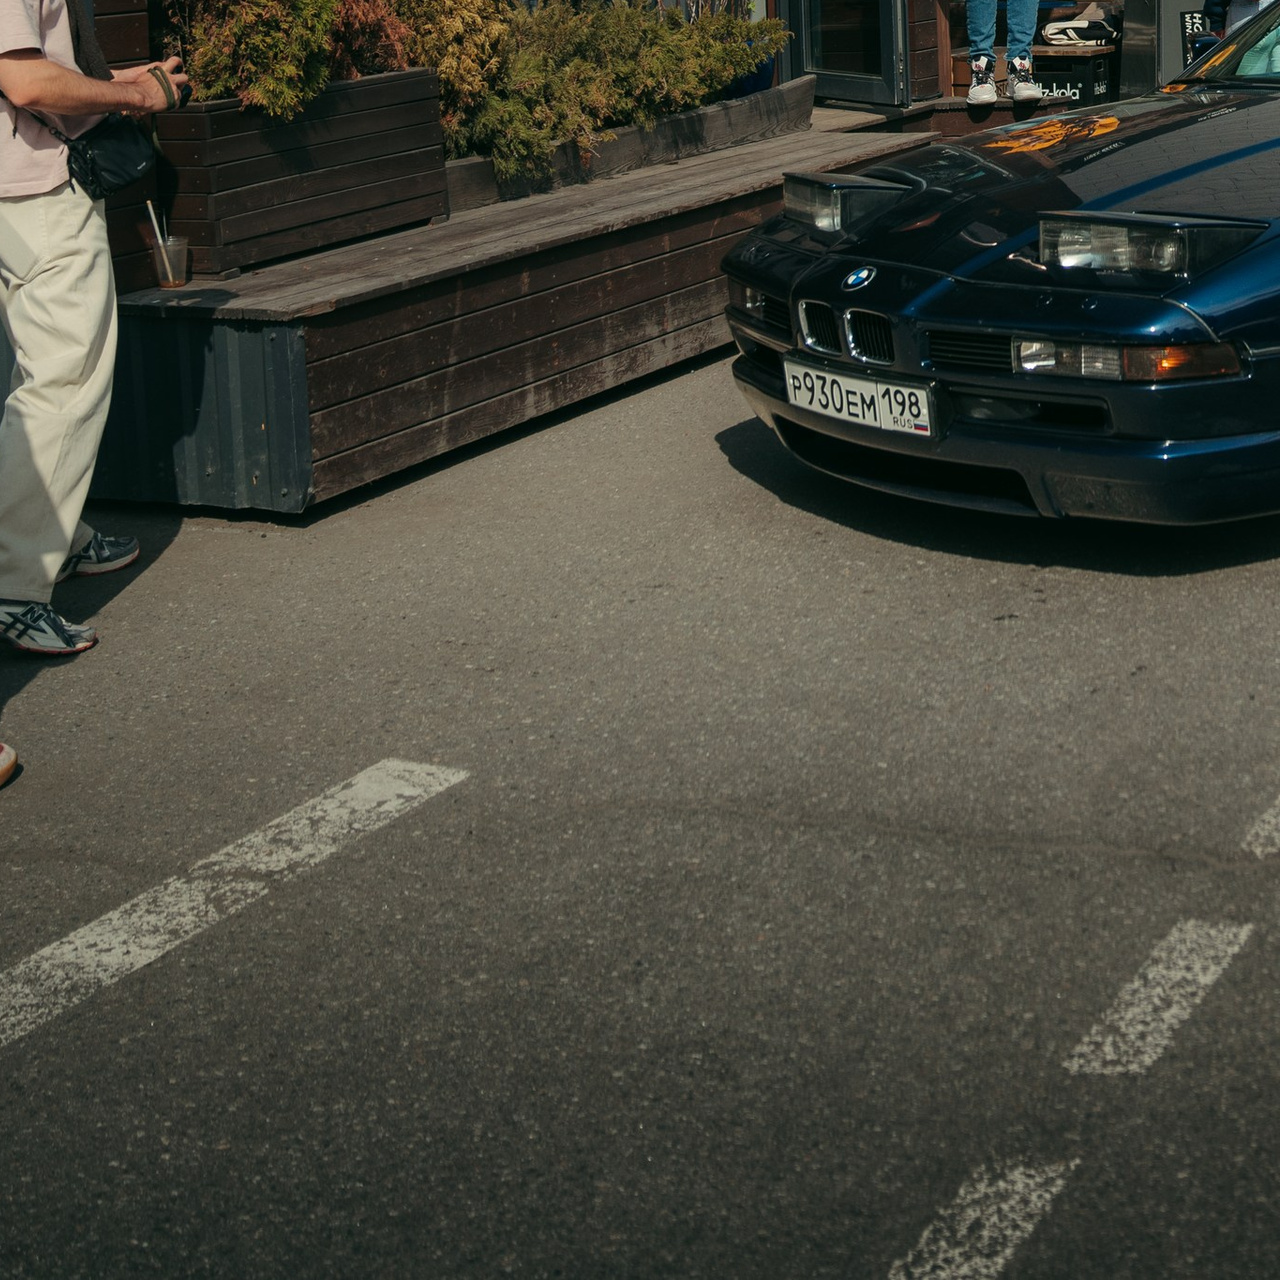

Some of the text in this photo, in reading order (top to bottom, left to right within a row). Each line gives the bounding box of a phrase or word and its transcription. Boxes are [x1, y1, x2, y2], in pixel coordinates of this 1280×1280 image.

[1184, 13, 1193, 36] WIN
[881, 387, 922, 419] 198
[893, 416, 913, 429] RUS
